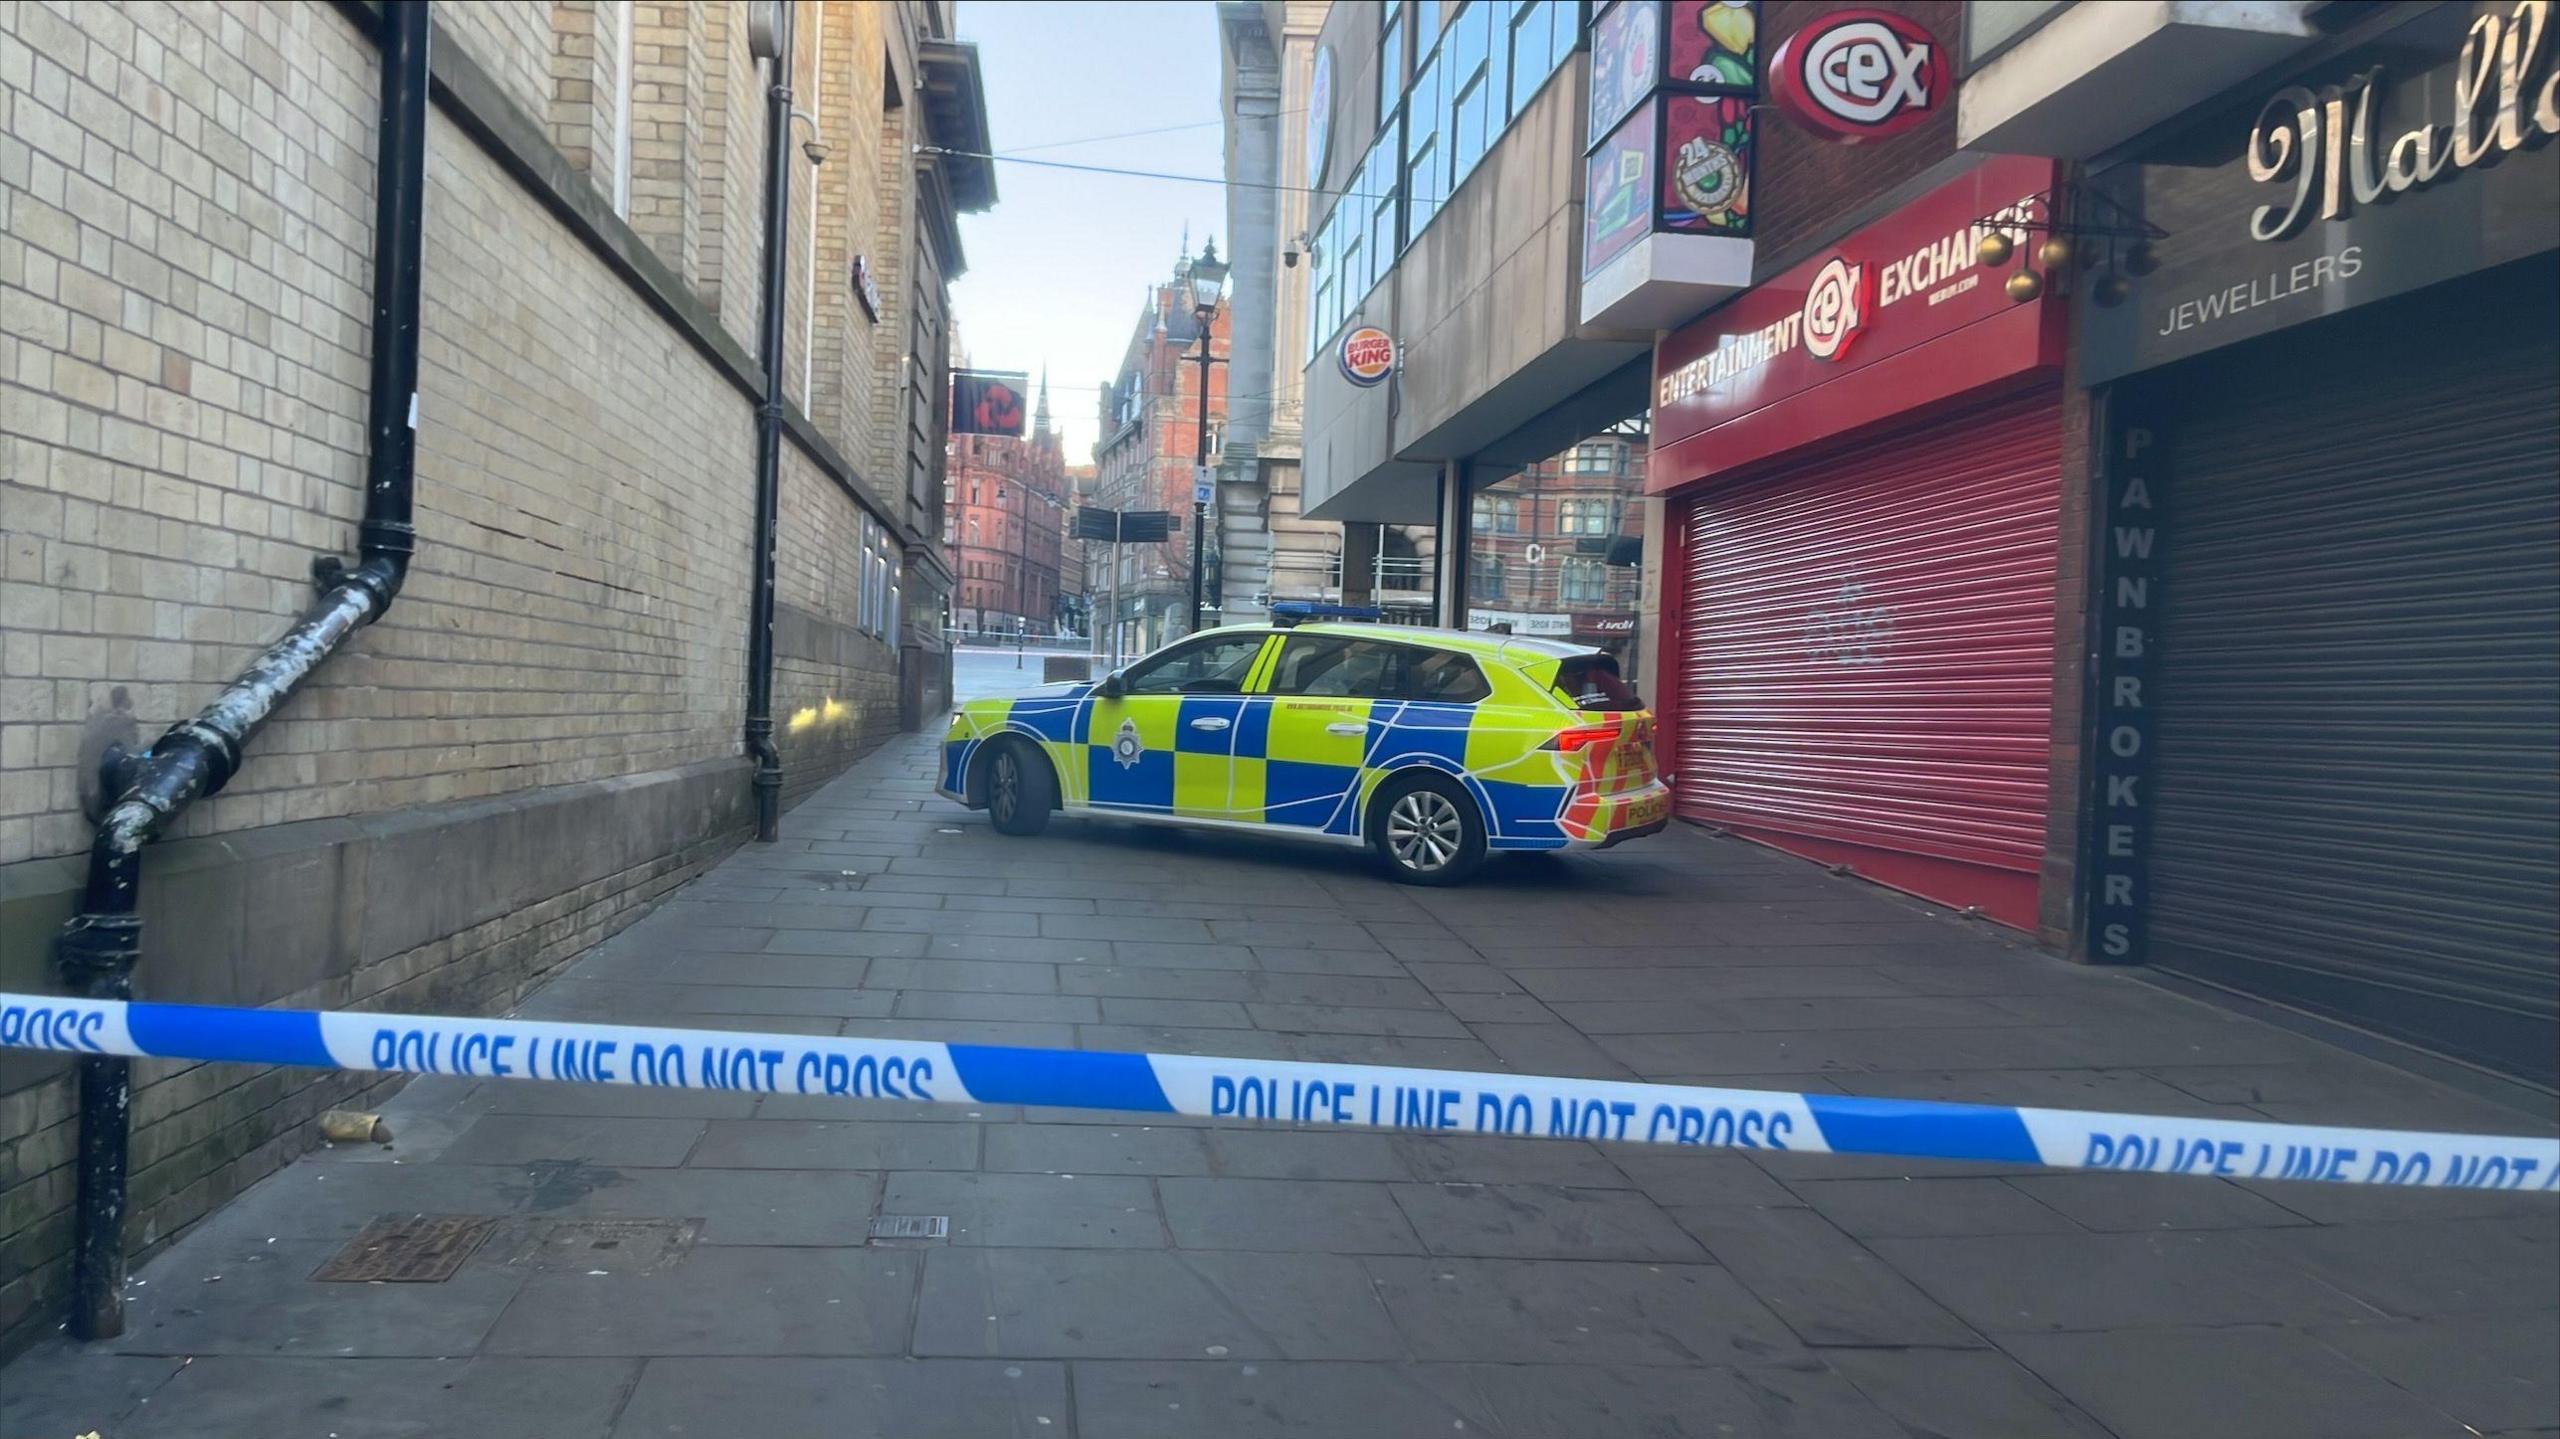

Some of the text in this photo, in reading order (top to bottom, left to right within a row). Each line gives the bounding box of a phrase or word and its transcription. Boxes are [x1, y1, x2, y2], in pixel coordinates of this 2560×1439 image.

[2159, 246, 2363, 336] JEWELLERS
[1348, 339, 1389, 353] BURGER
[1348, 349, 1391, 368] KING
[1660, 310, 1802, 408] ENTERTAINMENT
[2103, 428, 2154, 956] PAWNBROKERS
[700, 1047, 785, 1093] NOT
[1211, 1075, 1355, 1123] POLICE
[1550, 1097, 1636, 1142] NOT
